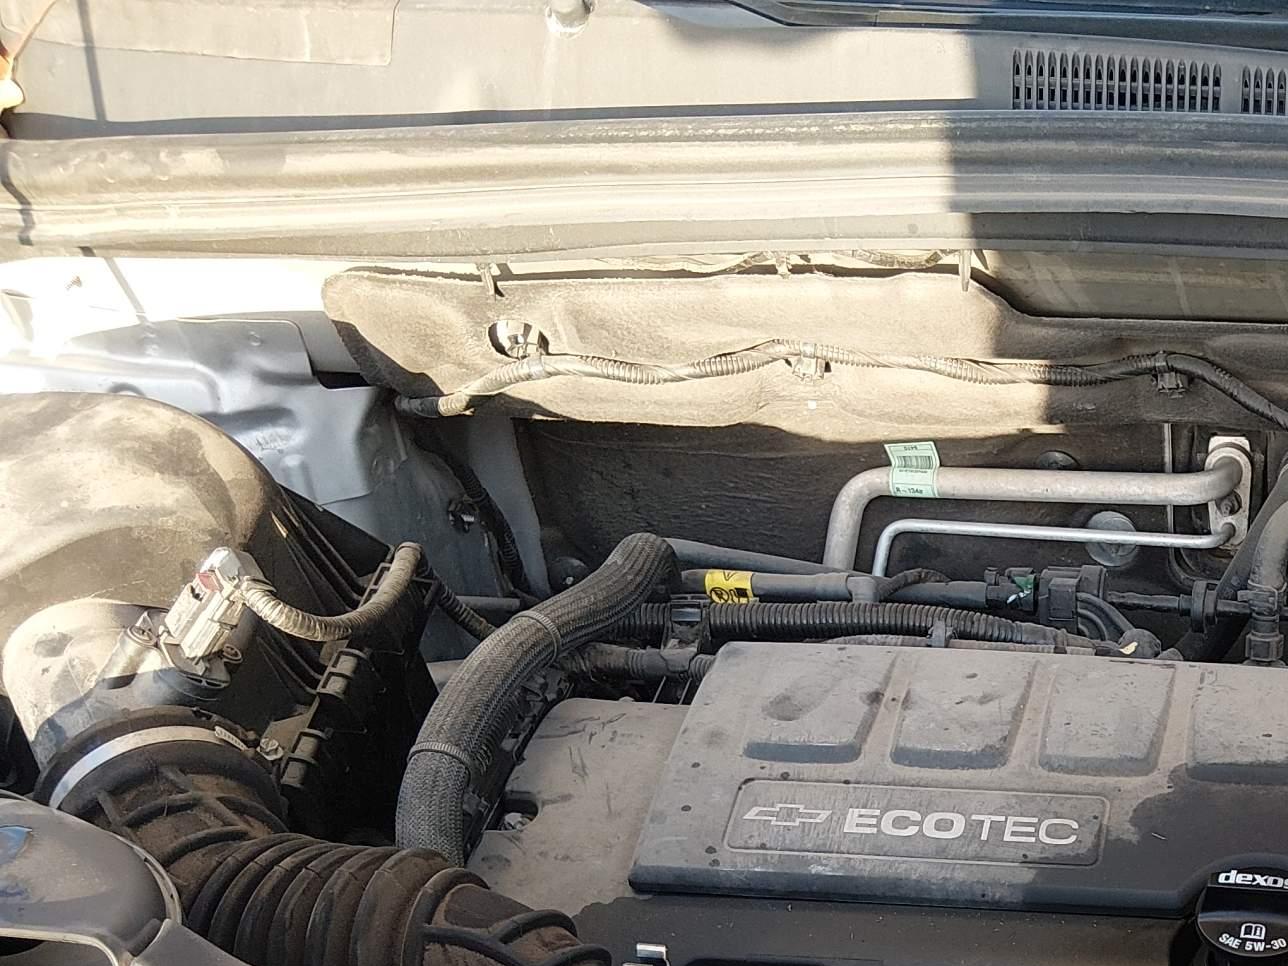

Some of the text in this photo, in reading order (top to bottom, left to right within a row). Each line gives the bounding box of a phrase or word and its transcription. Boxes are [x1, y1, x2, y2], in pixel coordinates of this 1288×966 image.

[843, 807, 1079, 845] ECOTEC
[1219, 933, 1287, 951] SAE 5W-30
